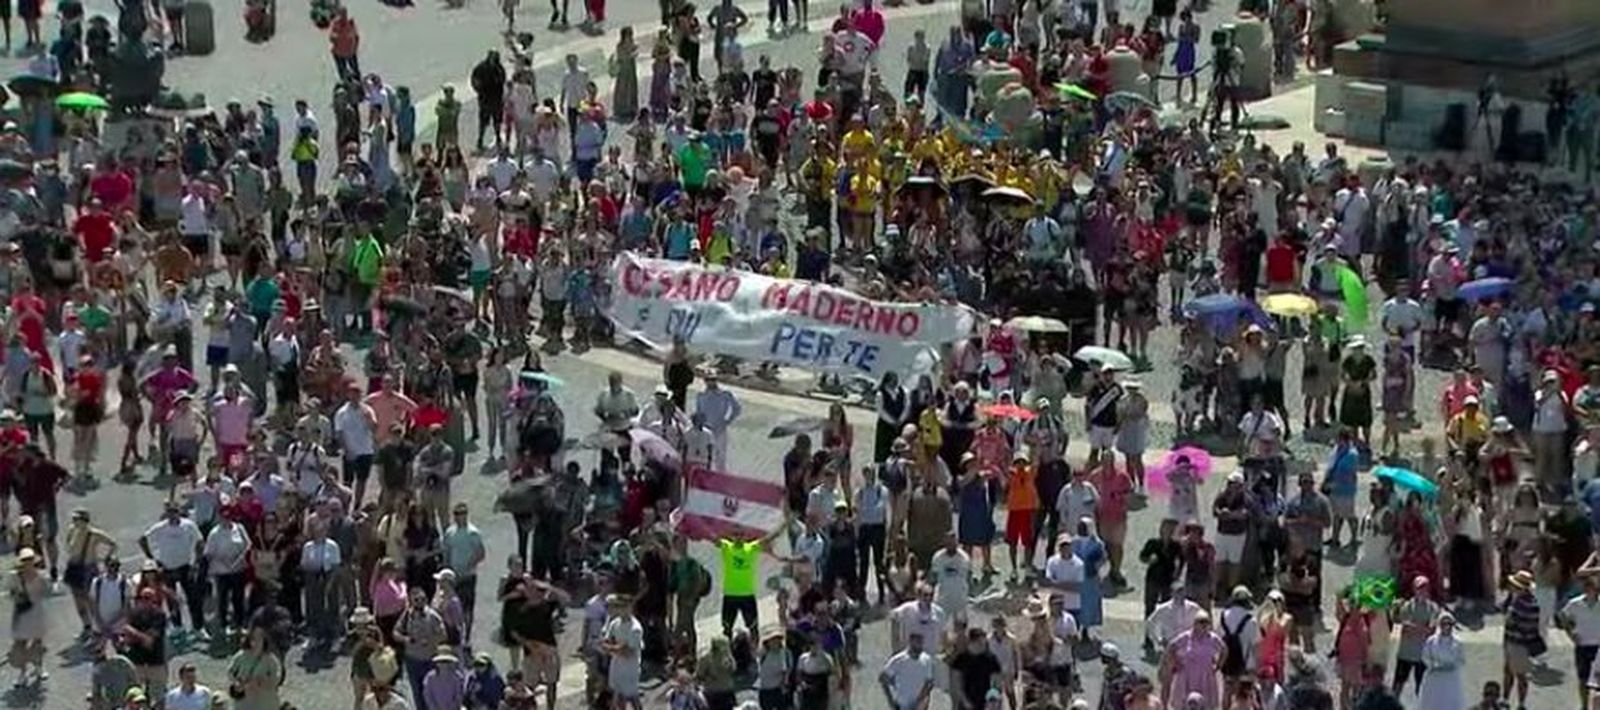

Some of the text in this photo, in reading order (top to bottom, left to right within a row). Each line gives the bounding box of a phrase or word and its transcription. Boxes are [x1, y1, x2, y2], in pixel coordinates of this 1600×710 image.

[622, 264, 920, 337] CESANO MADERNO
[771, 323, 833, 364] PER
[842, 341, 881, 373] TE
